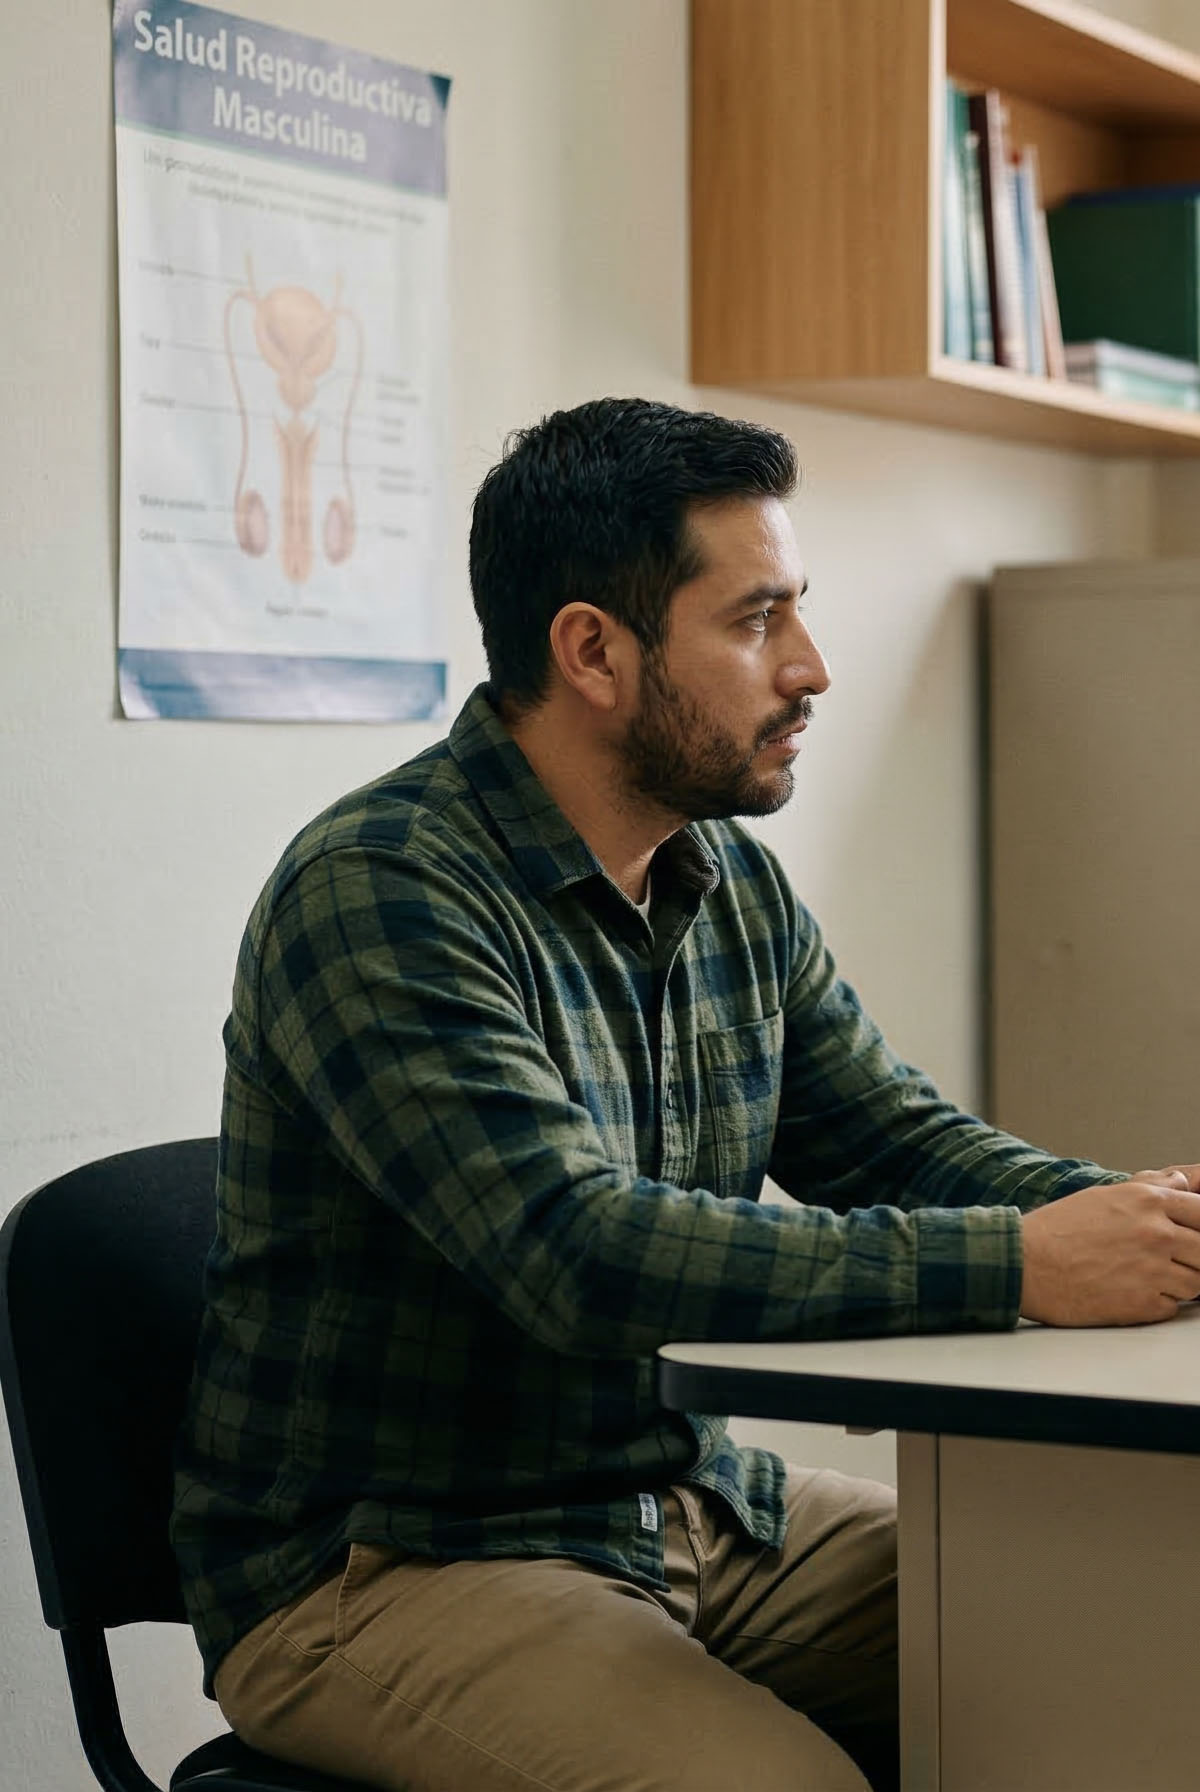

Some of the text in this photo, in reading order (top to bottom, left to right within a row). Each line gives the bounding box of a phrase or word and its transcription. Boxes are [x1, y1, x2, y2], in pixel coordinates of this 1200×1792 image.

[133, 10, 432, 127] Salud Reproductiva
[213, 87, 367, 162] Masculina
